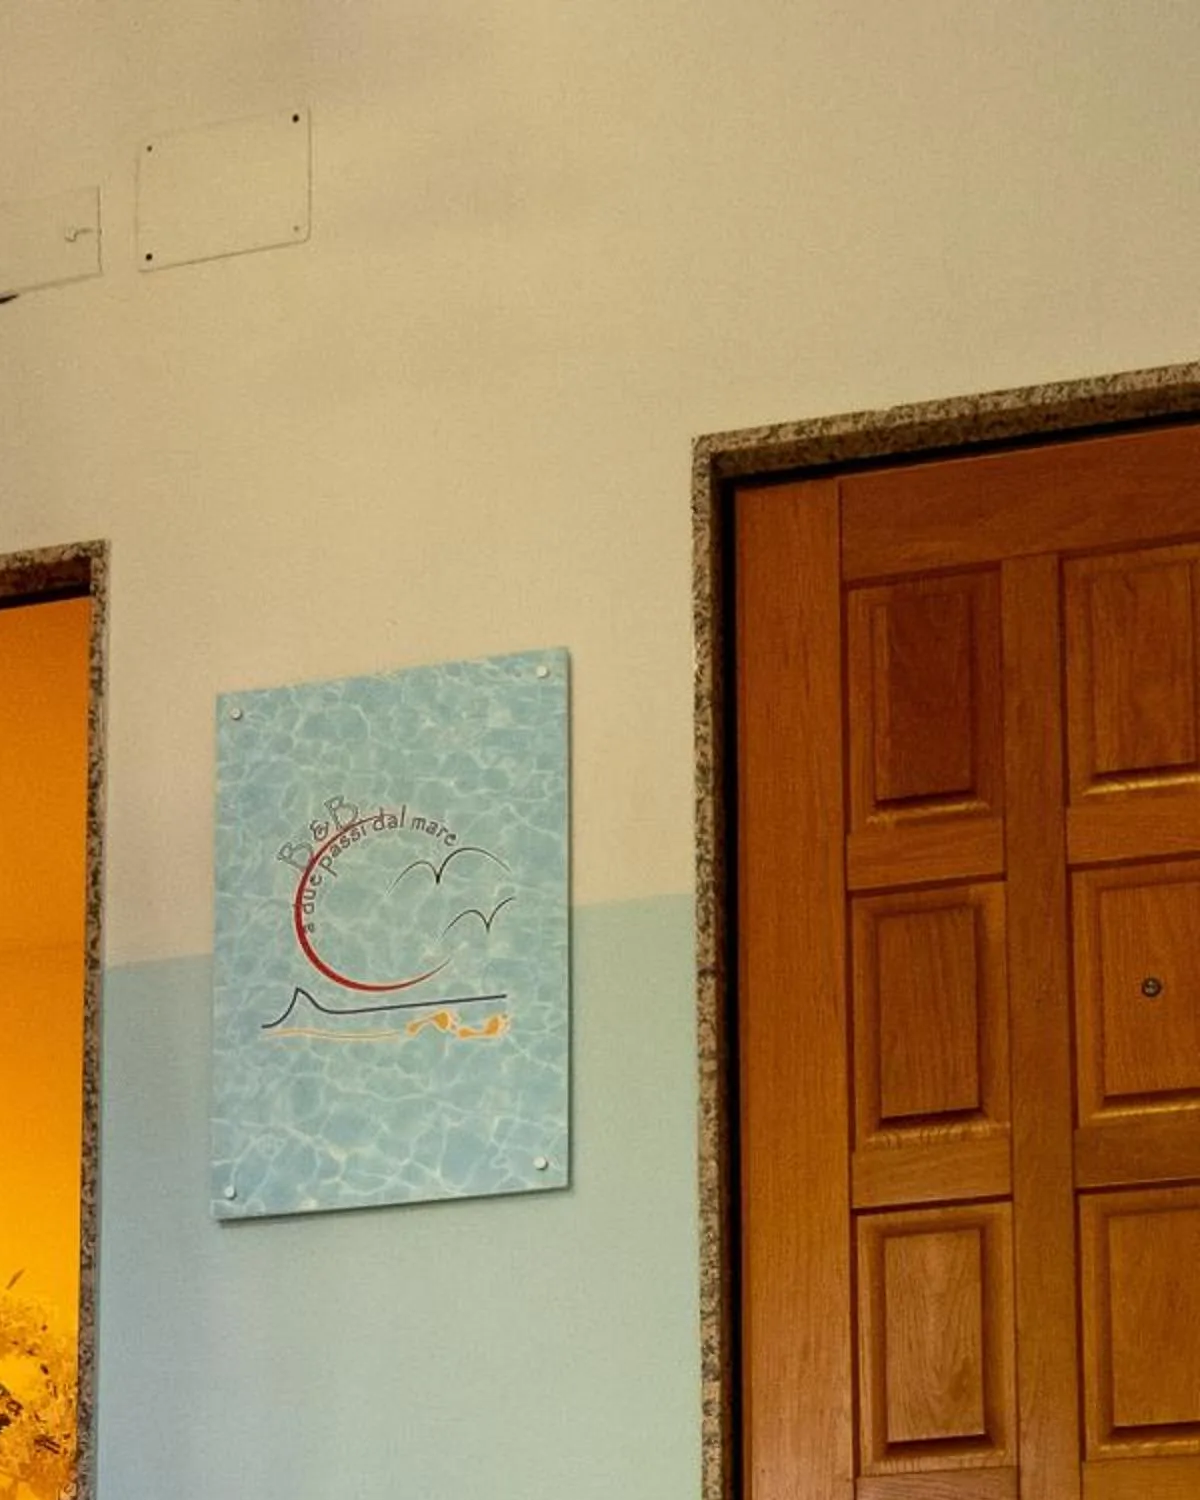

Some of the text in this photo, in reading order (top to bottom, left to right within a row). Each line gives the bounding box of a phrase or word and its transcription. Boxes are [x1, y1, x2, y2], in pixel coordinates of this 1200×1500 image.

[293, 804, 457, 934] a due passi dal mare
